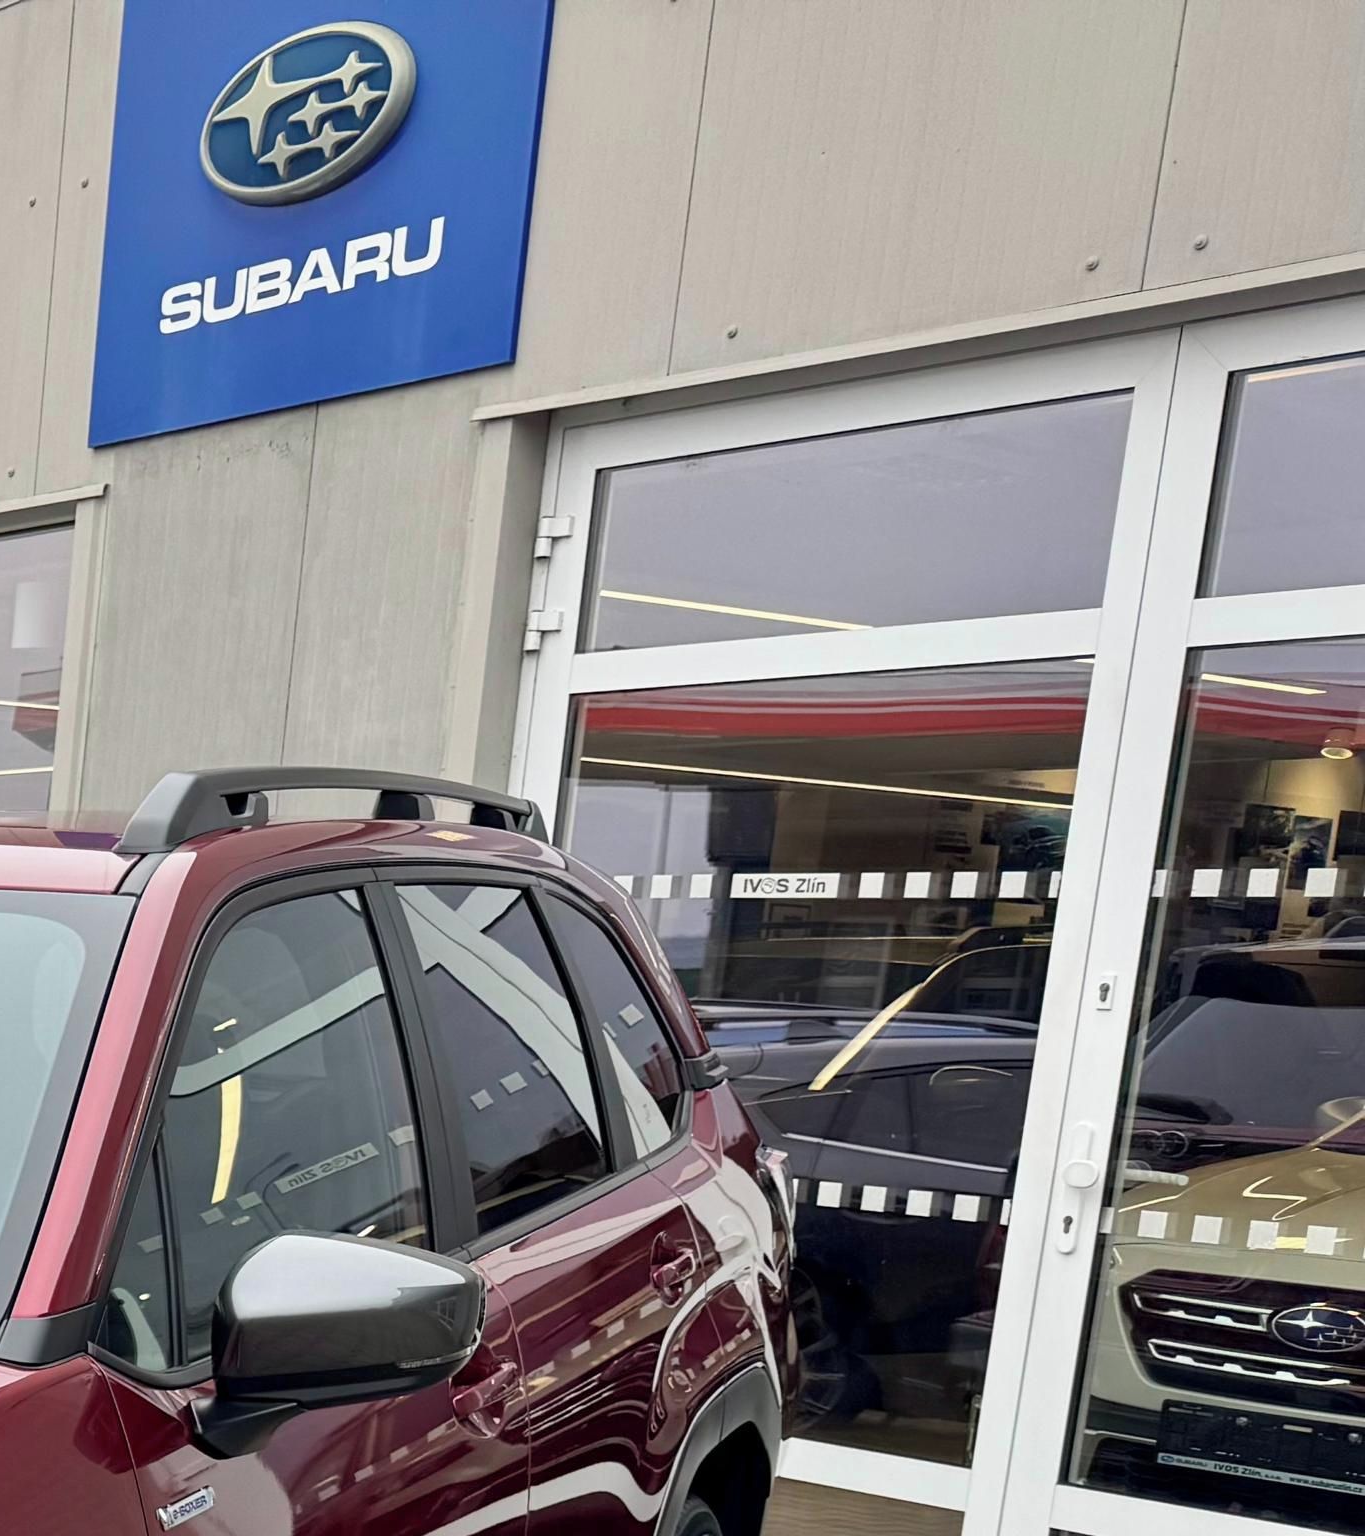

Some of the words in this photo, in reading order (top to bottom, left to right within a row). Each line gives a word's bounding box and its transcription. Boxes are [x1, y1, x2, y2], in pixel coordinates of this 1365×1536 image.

[159, 216, 445, 334] SUBARU
[794, 877, 826, 893] Zlín
[1213, 1462, 1240, 1474] IVOS
[172, 1495, 208, 1520] e-BOXER
